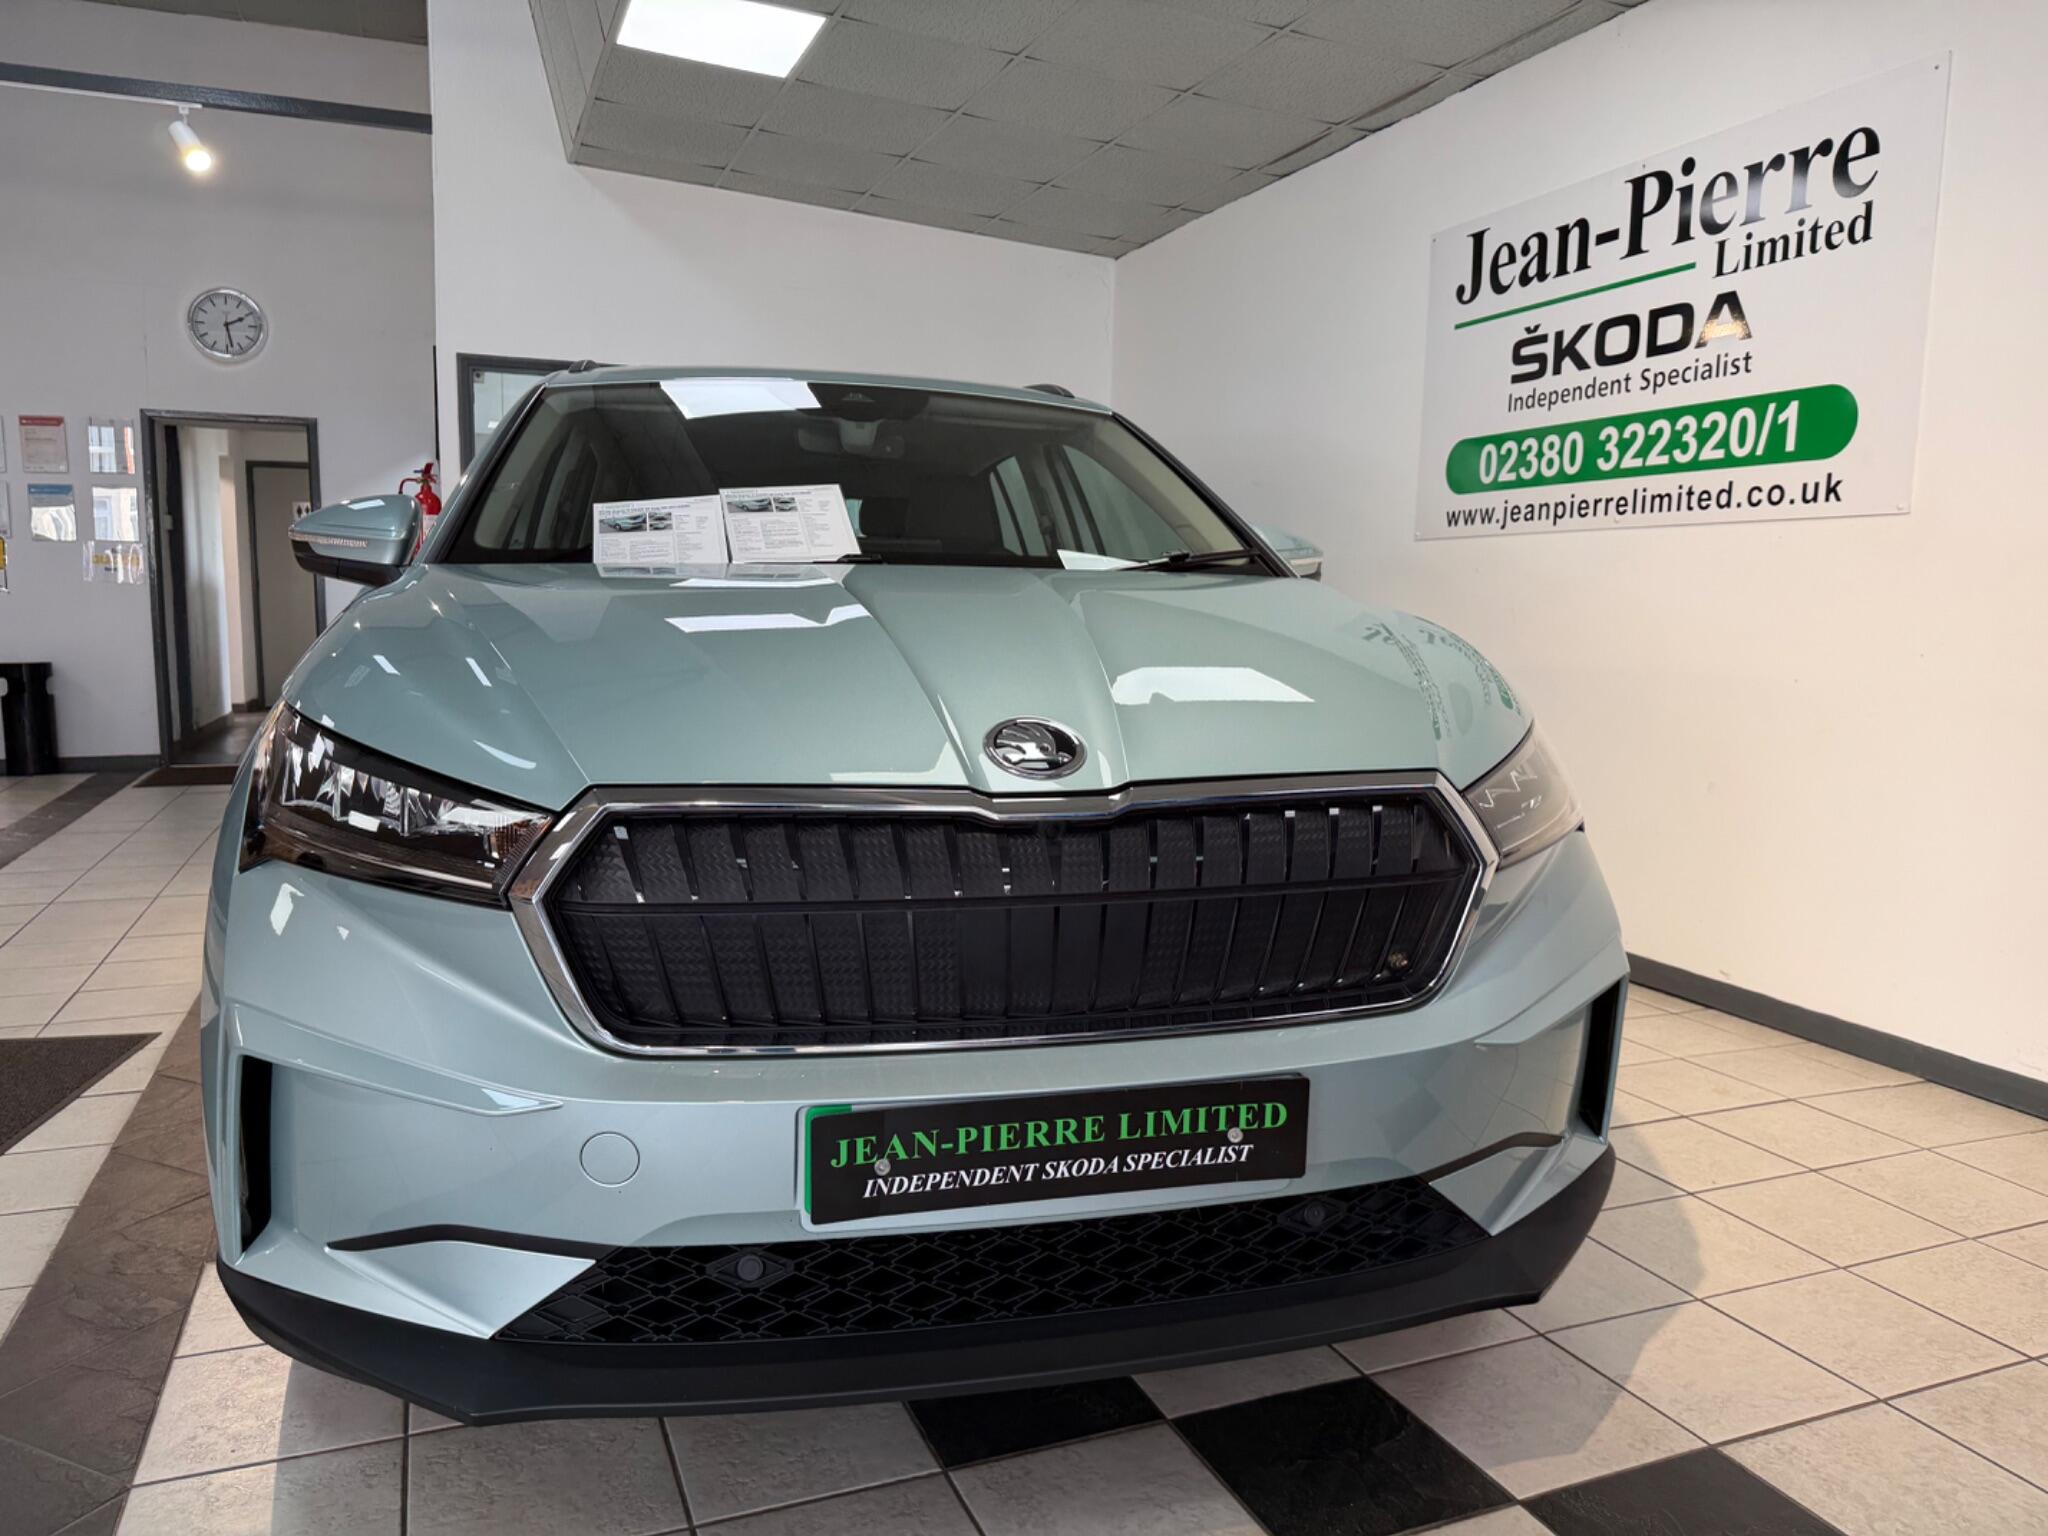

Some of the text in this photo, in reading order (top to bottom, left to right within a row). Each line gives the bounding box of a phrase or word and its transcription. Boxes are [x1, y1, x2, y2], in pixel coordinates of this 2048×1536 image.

[1457, 126, 1880, 304] Jean-Pierre
[1713, 200, 1874, 278] Limited
[1511, 290, 1752, 383] ŠKODA
[1507, 352, 1752, 412] Independent Specialist
[1479, 401, 1800, 485] 02380 322320/1
[1446, 473, 1843, 529] www.jeanpierrelimited.co.uk
[830, 1101, 1288, 1169] JEAN-PIERRE LIMITED
[862, 1144, 1254, 1198] INDEPENDENT SKODA SPECIALIST
